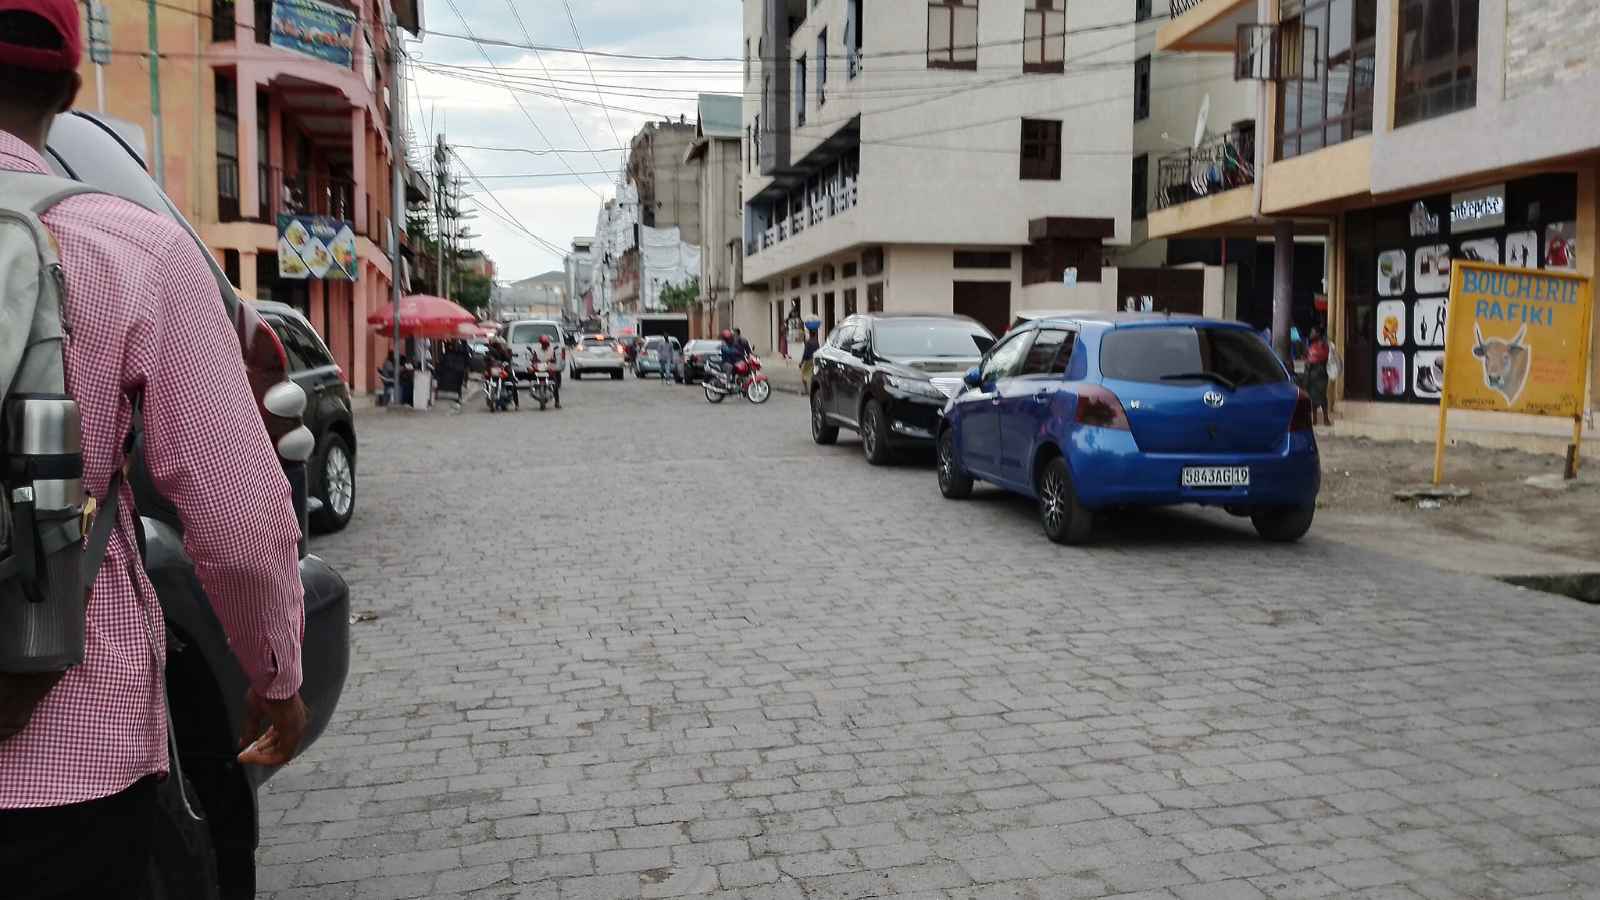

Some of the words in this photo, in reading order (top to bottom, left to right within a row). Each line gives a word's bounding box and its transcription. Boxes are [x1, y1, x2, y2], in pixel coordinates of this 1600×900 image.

[1462, 269, 1579, 304] BOUCHERIE
[1475, 299, 1553, 327] RAFIKI
[1234, 469, 1248, 483] 19
